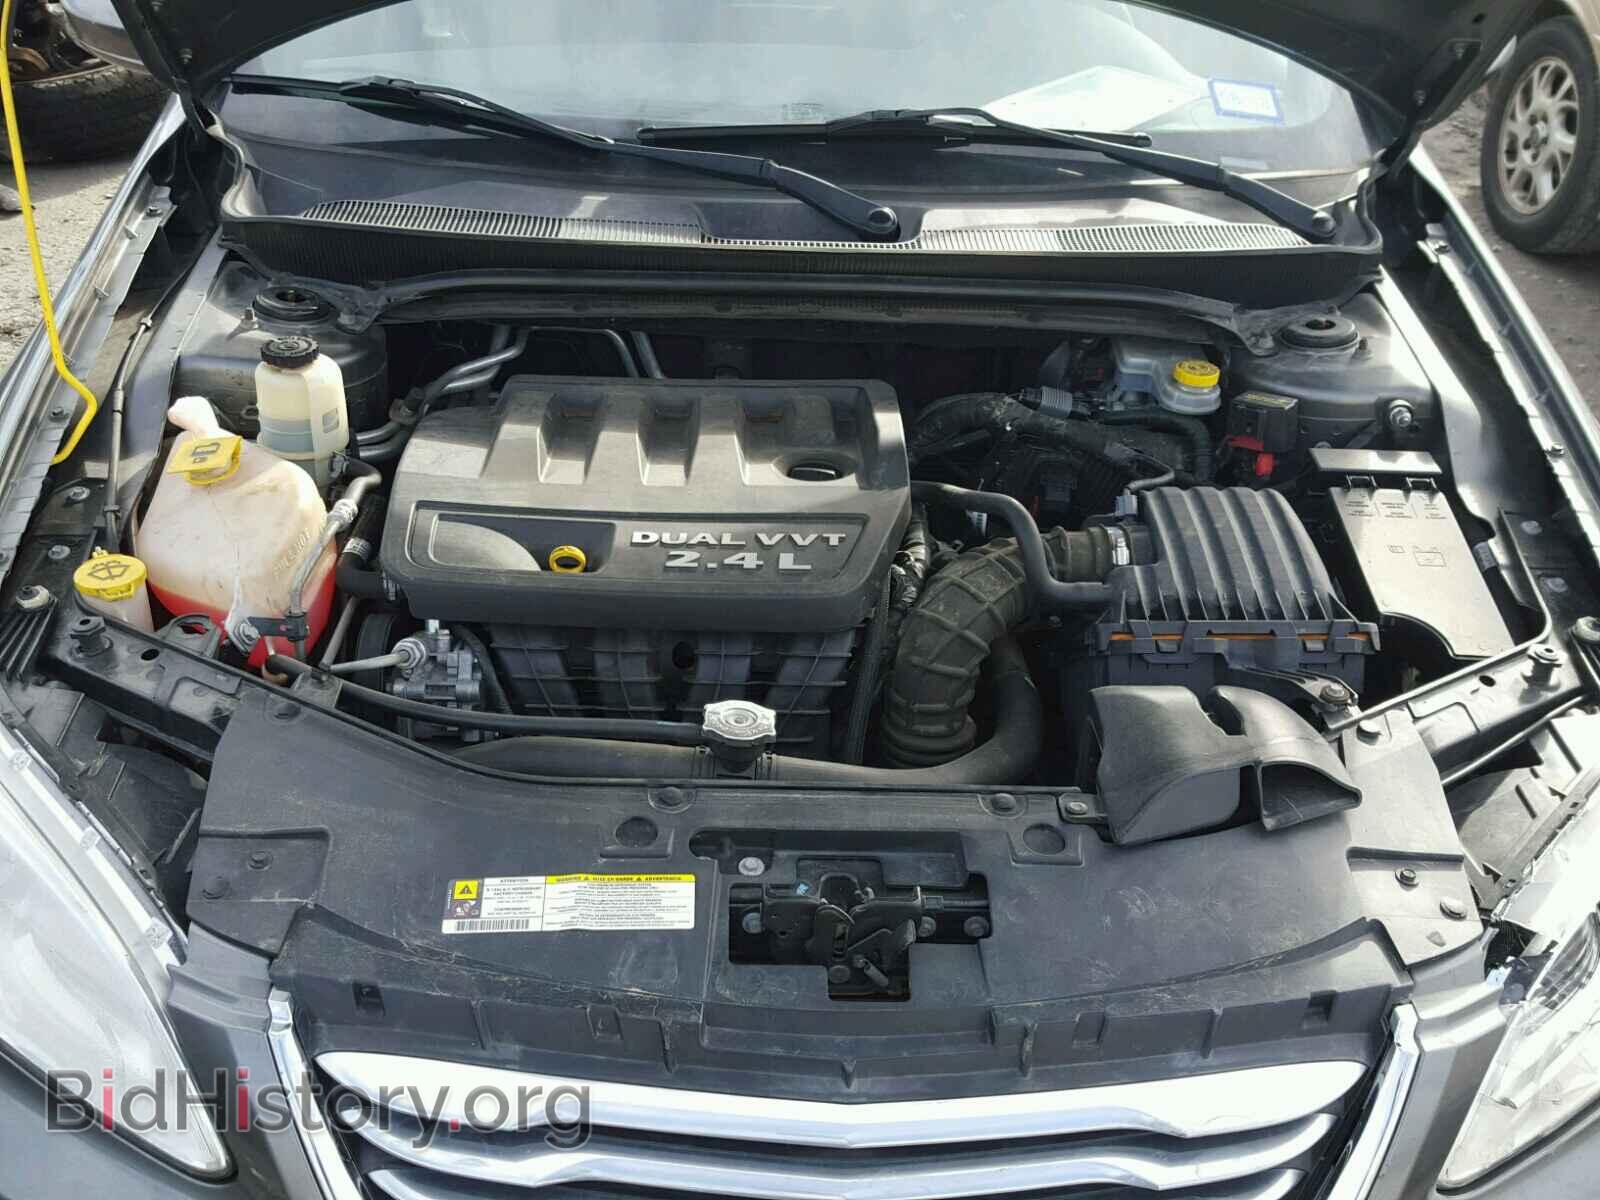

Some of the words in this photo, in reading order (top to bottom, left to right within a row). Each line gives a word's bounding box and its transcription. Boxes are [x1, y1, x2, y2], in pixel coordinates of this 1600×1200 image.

[631, 531, 746, 546] DUAL
[756, 533, 846, 546] VVT
[665, 551, 764, 569] 2.4
[778, 552, 812, 570] L
